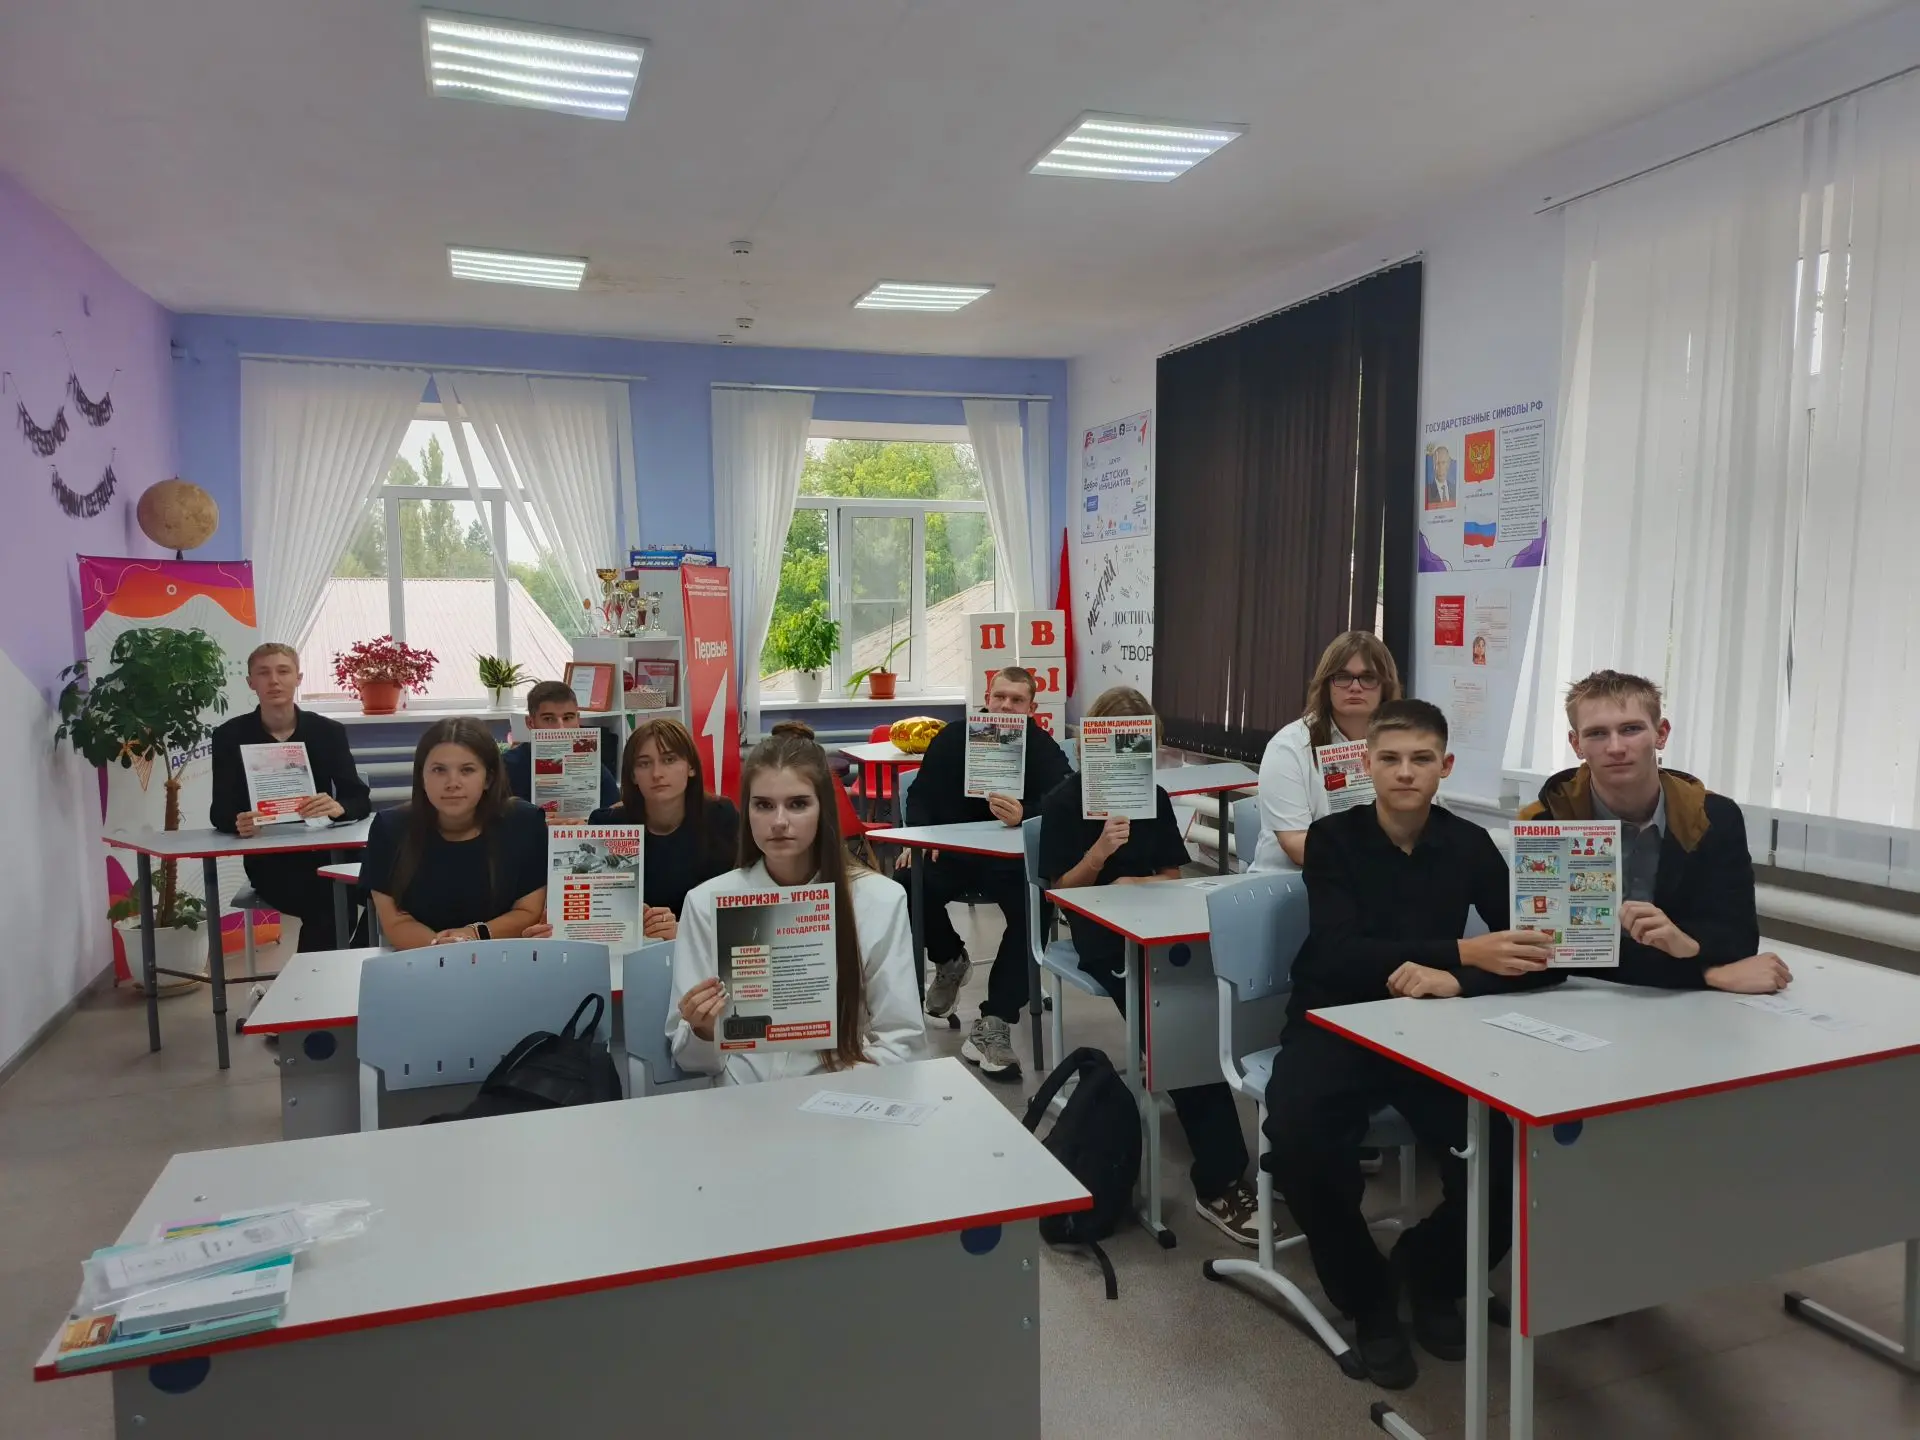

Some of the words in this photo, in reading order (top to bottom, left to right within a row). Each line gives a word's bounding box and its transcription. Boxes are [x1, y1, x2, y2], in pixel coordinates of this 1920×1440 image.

[1425, 411, 1490, 434] ГОСУДАРСТВЕННЫЕ
[1492, 404, 1529, 419] СИМВОЛЫ
[1530, 400, 1543, 412] РФ
[1101, 469, 1129, 482] ДЕТСКИХ
[1112, 611, 1154, 628] ДОСТИГА
[694, 636, 728, 666] Первые
[1107, 719, 1152, 727] МЕДИЦИНСКАЯ
[1083, 727, 1112, 735] ПОМОЩЬ
[1331, 746, 1349, 754] ВЕСТИ
[553, 830, 573, 838] КАК
[577, 829, 640, 838] ПРАВИЛЬНО
[1514, 825, 1561, 836] ПРАВИЛА
[716, 892, 780, 907] ТЕРРОРИЗМ
[791, 889, 830, 902] УГРОЗА
[815, 903, 830, 912] ДЛЯ
[796, 913, 830, 923] ЧЕЛОВЕКА
[782, 924, 830, 935] ГОСУДАРСТВА
